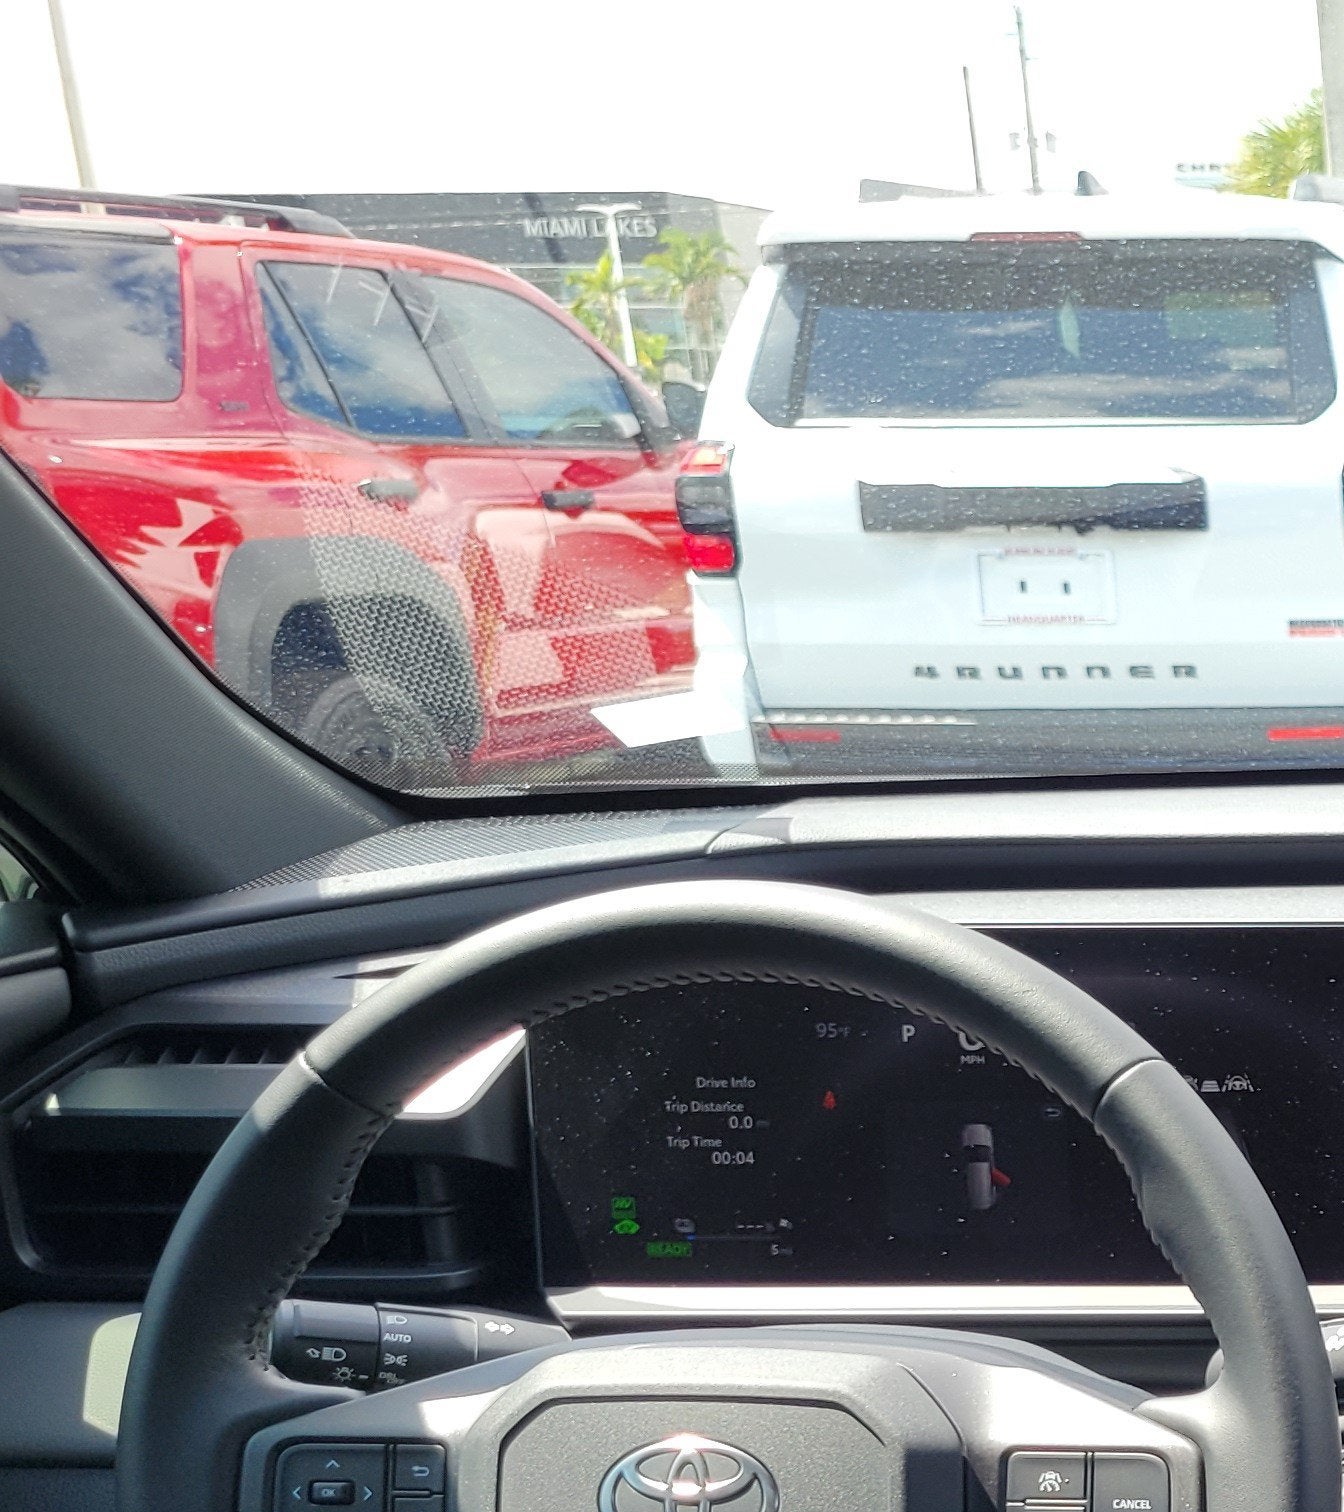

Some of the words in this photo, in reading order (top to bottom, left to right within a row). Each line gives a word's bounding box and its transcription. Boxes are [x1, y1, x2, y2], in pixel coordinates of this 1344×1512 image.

[524, 217, 588, 238] MIAMI
[913, 664, 1200, 681] 4RUNNER
[901, 1024, 916, 1043] P
[960, 1055, 986, 1065] MPH
[695, 1076, 729, 1089] Drive
[732, 1075, 757, 1089] Info
[664, 1100, 689, 1115] Trip
[690, 1100, 745, 1113] Distance
[728, 1115, 754, 1130] 0.0
[666, 1135, 691, 1150] Trip
[692, 1135, 723, 1148] Time
[711, 1151, 756, 1165] 00:04
[383, 1332, 412, 1343] AUTO
[321, 1488, 336, 1498] OK
[1112, 1498, 1152, 1510] CANCEL
